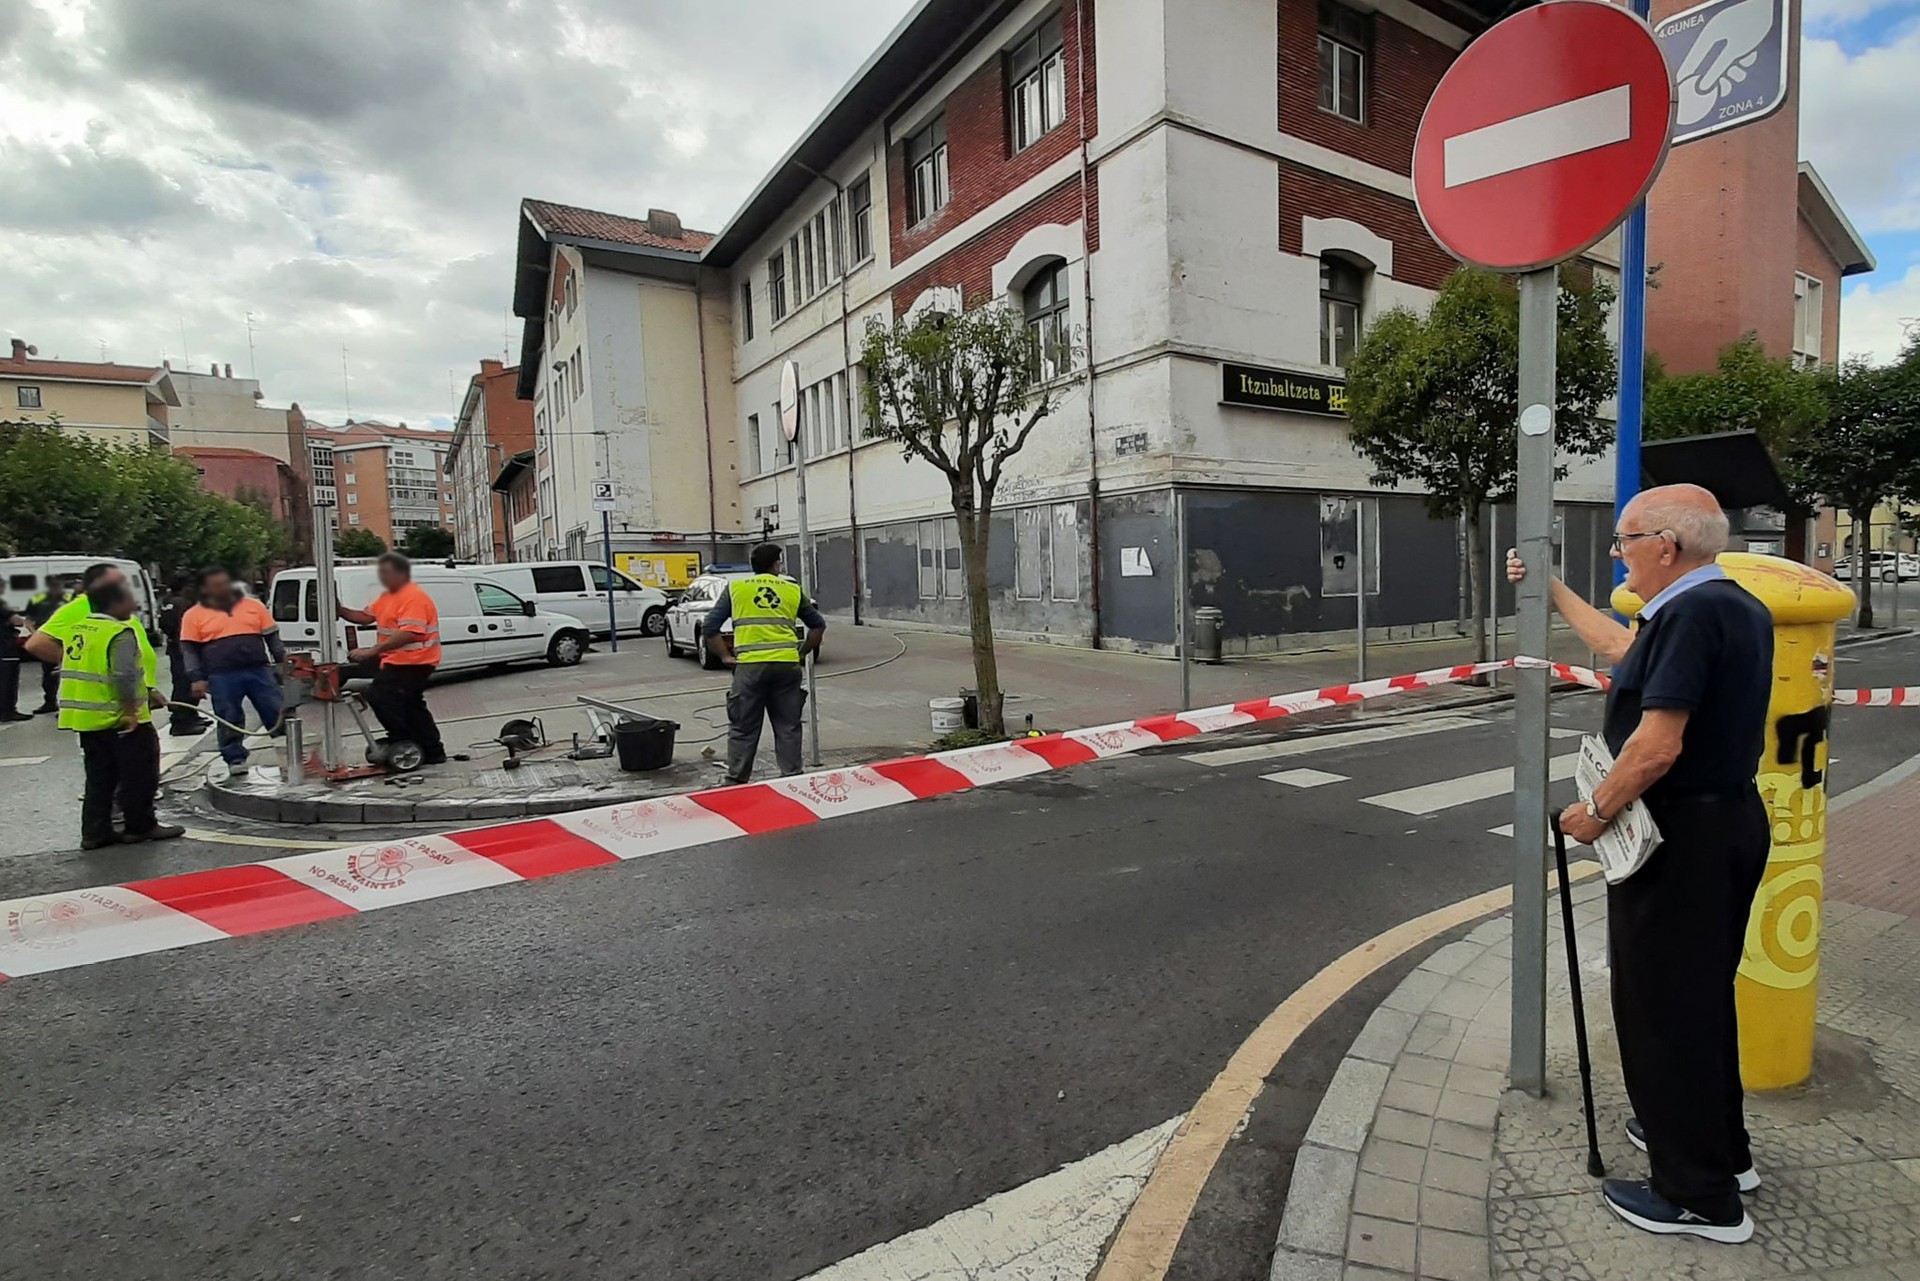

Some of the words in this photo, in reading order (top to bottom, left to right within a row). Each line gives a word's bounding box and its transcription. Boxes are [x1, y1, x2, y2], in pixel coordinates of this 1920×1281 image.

[1719, 100, 1753, 119] ZONA
[1756, 96, 1764, 106] 4
[1240, 374, 1321, 400] Itzubaltzeta
[1583, 746, 1595, 764] EL
[404, 839, 419, 848] EZ
[418, 843, 454, 865] PASATU
[309, 865, 326, 878] NO
[326, 874, 359, 893] PASAR
[347, 855, 406, 890] ERTZAINTZA
